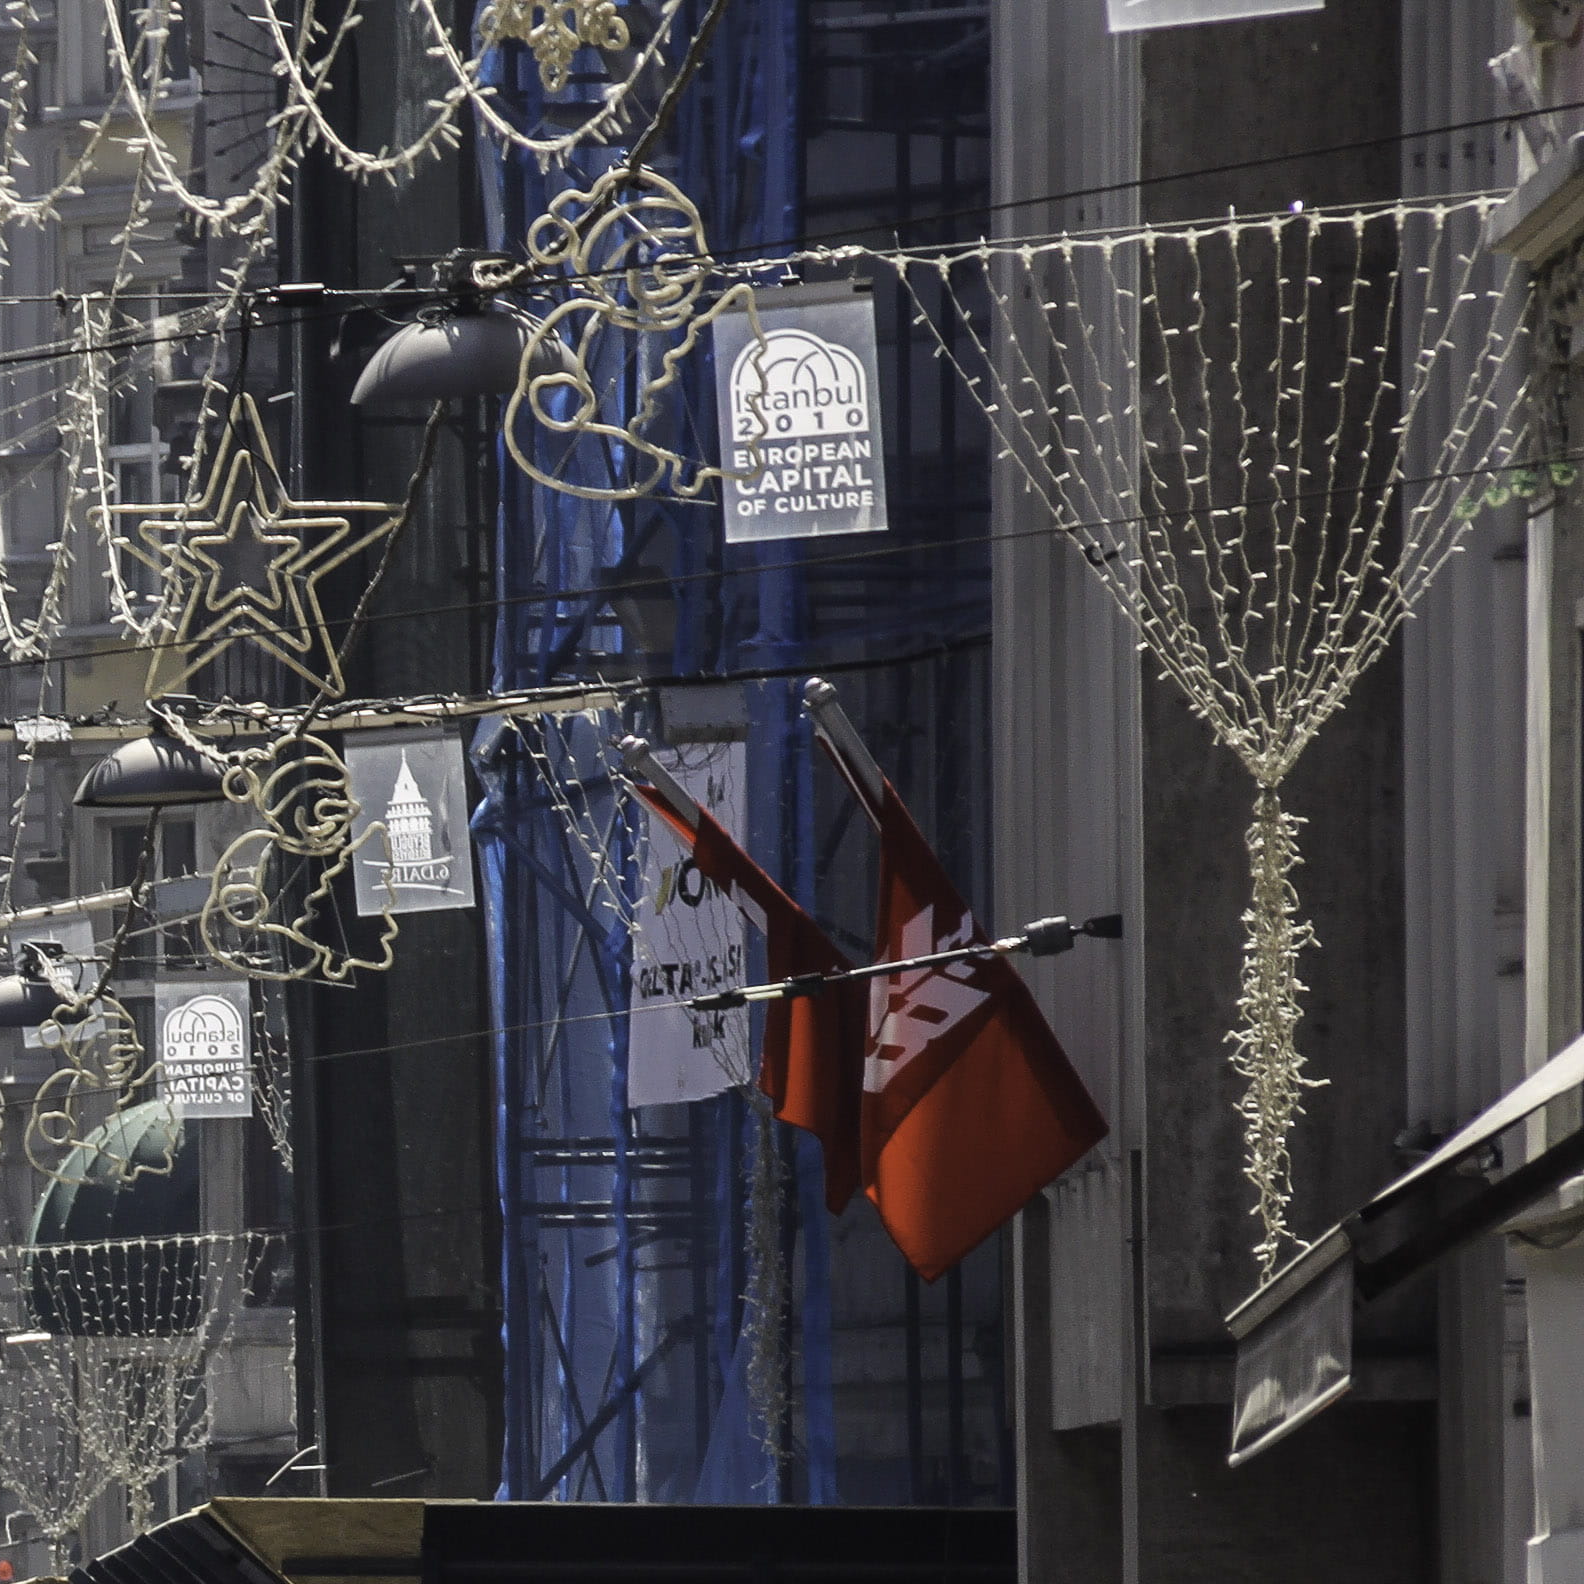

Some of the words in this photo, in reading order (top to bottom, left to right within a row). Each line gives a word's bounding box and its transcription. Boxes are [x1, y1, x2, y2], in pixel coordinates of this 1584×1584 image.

[734, 440, 872, 469] EUROPEAN
[735, 463, 873, 496] CAPITAL
[737, 499, 767, 517] OF
[774, 490, 875, 514] CULTURE
